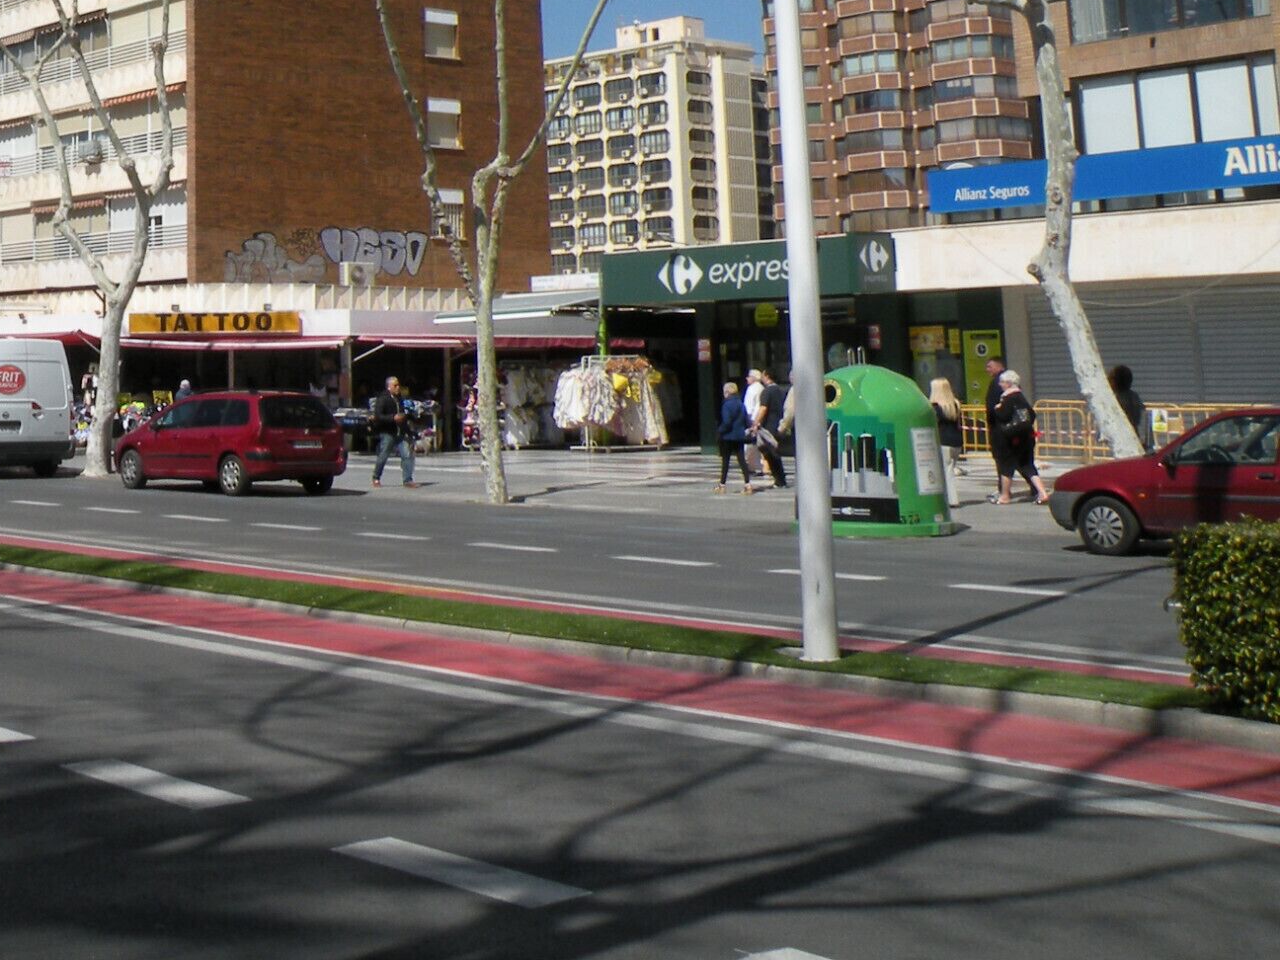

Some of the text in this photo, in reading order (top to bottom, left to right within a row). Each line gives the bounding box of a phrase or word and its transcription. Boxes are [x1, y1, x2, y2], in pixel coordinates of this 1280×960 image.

[1223, 143, 1280, 176] Alli
[954, 185, 1030, 202] Allianz Seguros
[708, 258, 790, 289] expres
[155, 313, 272, 332] TATTOO
